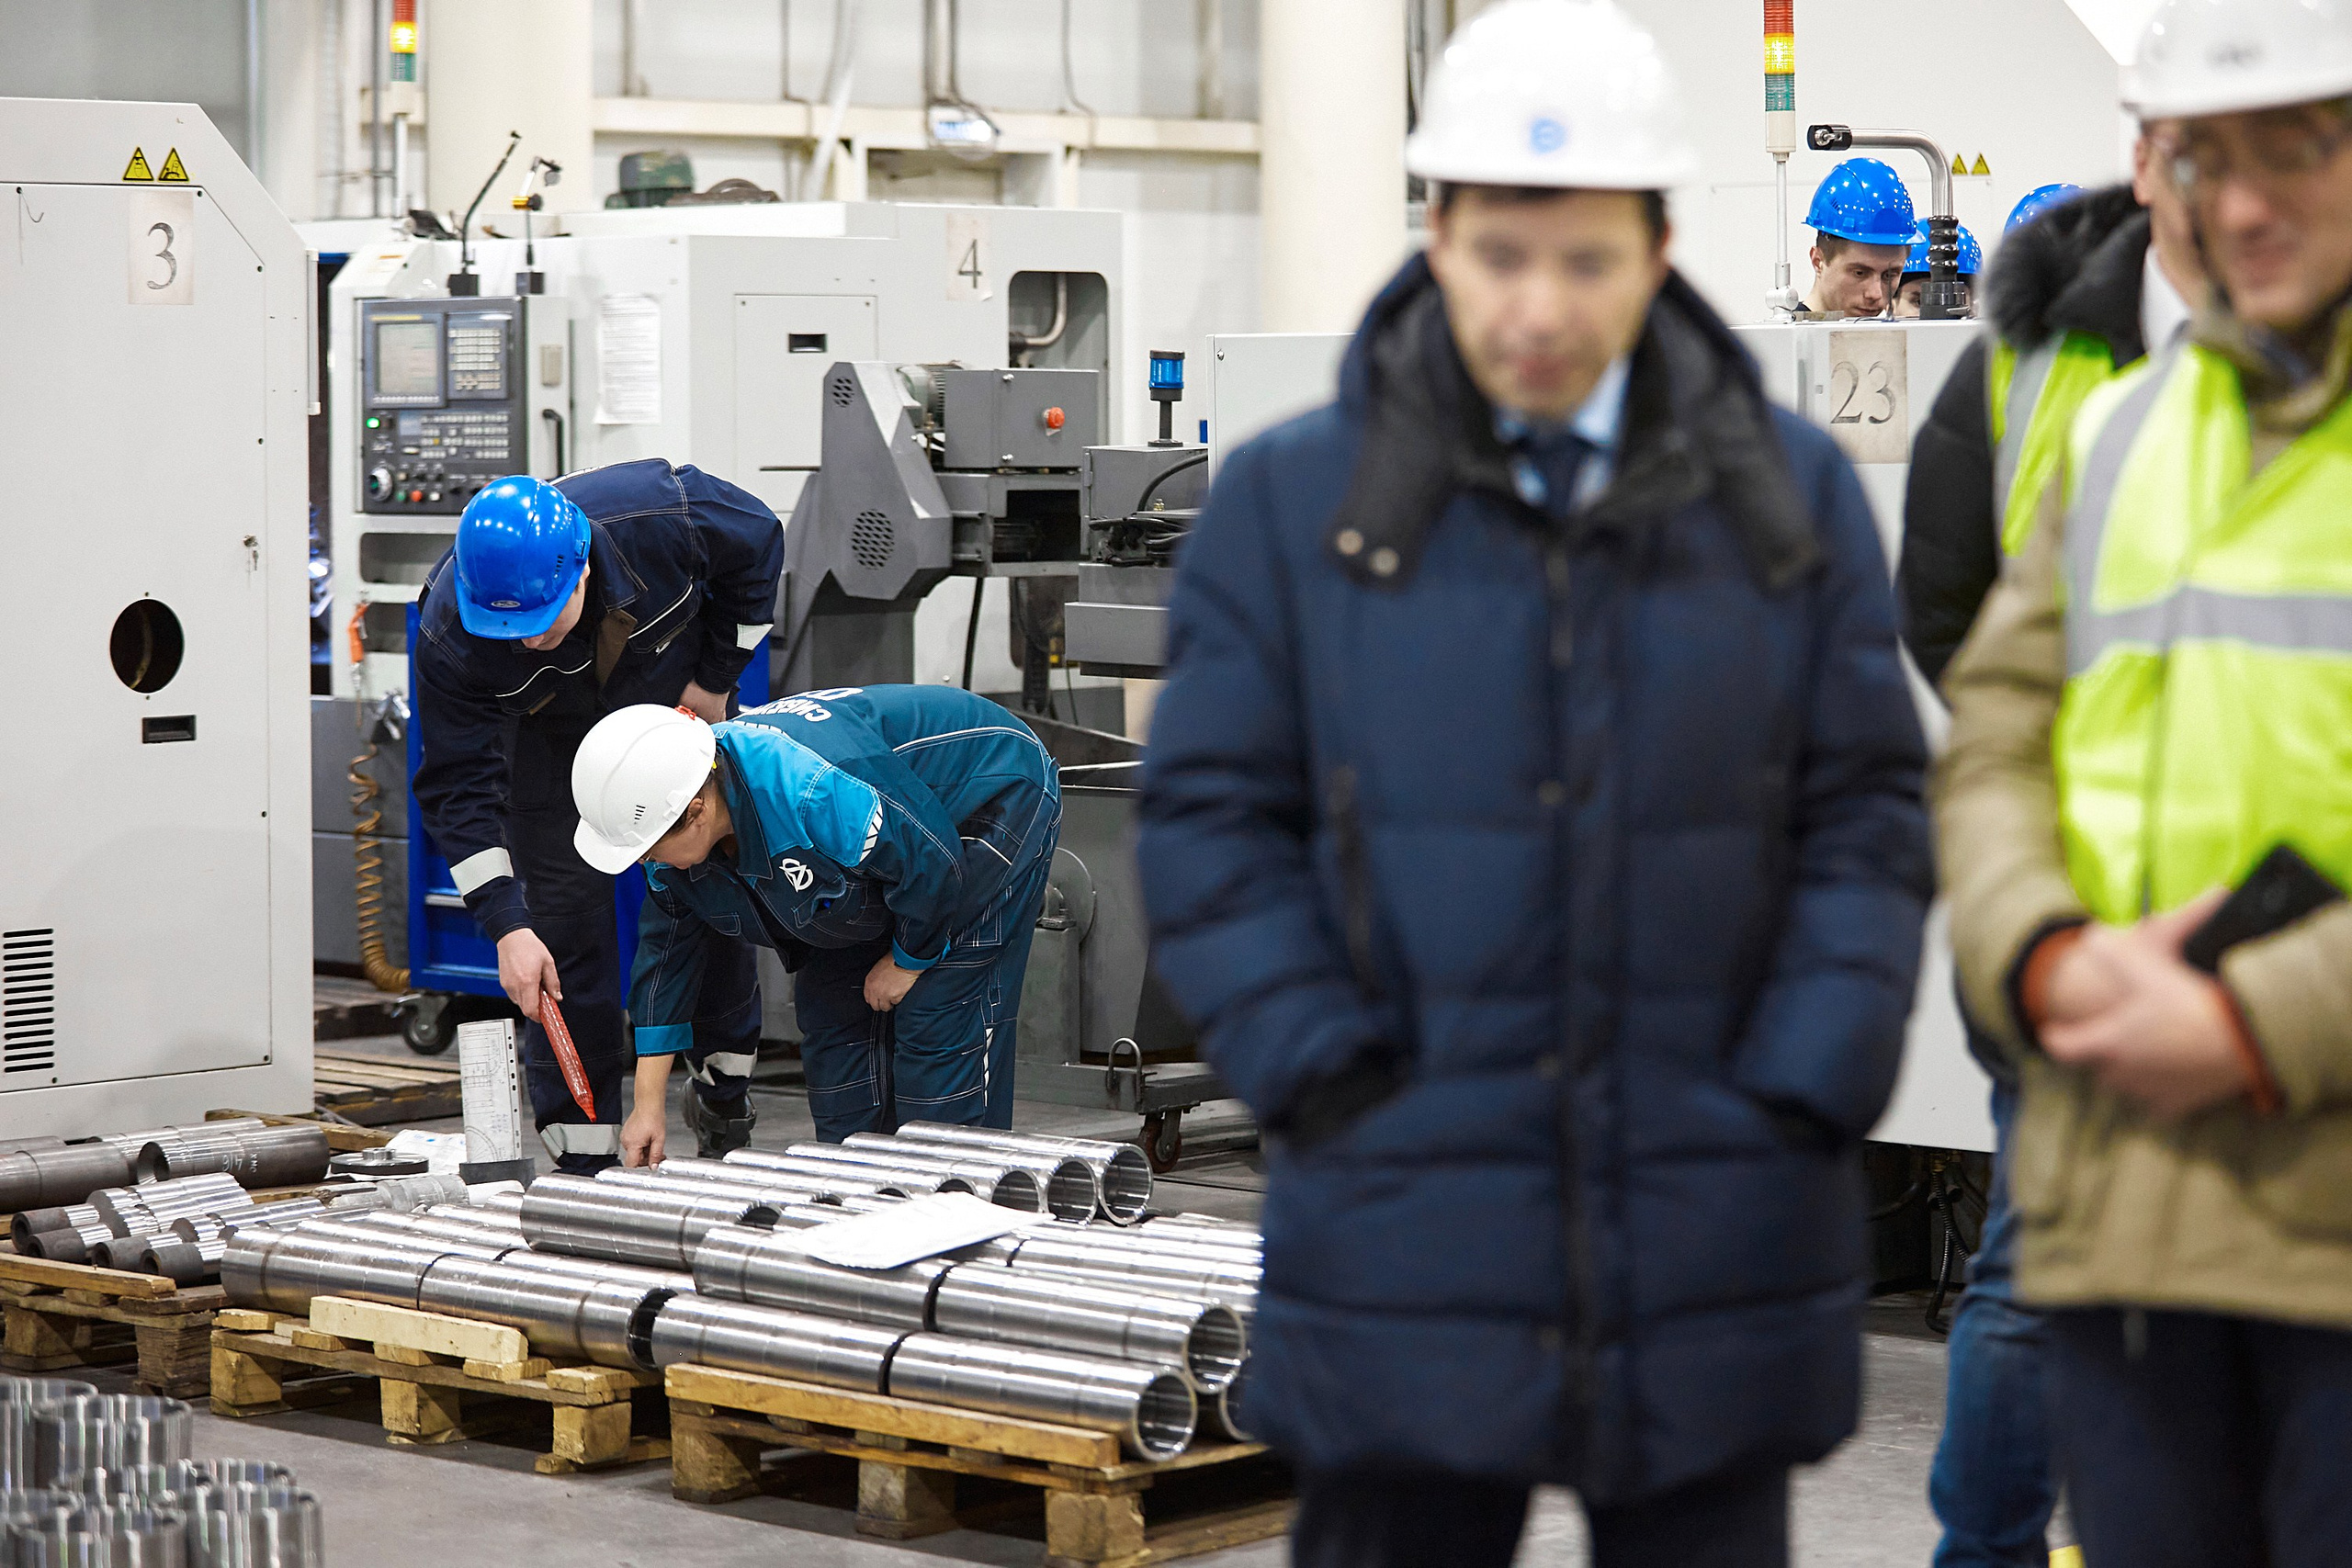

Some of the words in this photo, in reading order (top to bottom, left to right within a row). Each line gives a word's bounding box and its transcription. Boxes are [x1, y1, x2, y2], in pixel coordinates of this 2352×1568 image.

[147, 221, 177, 290] 3
[958, 238, 983, 289] 4
[1830, 360, 1896, 424] 23
